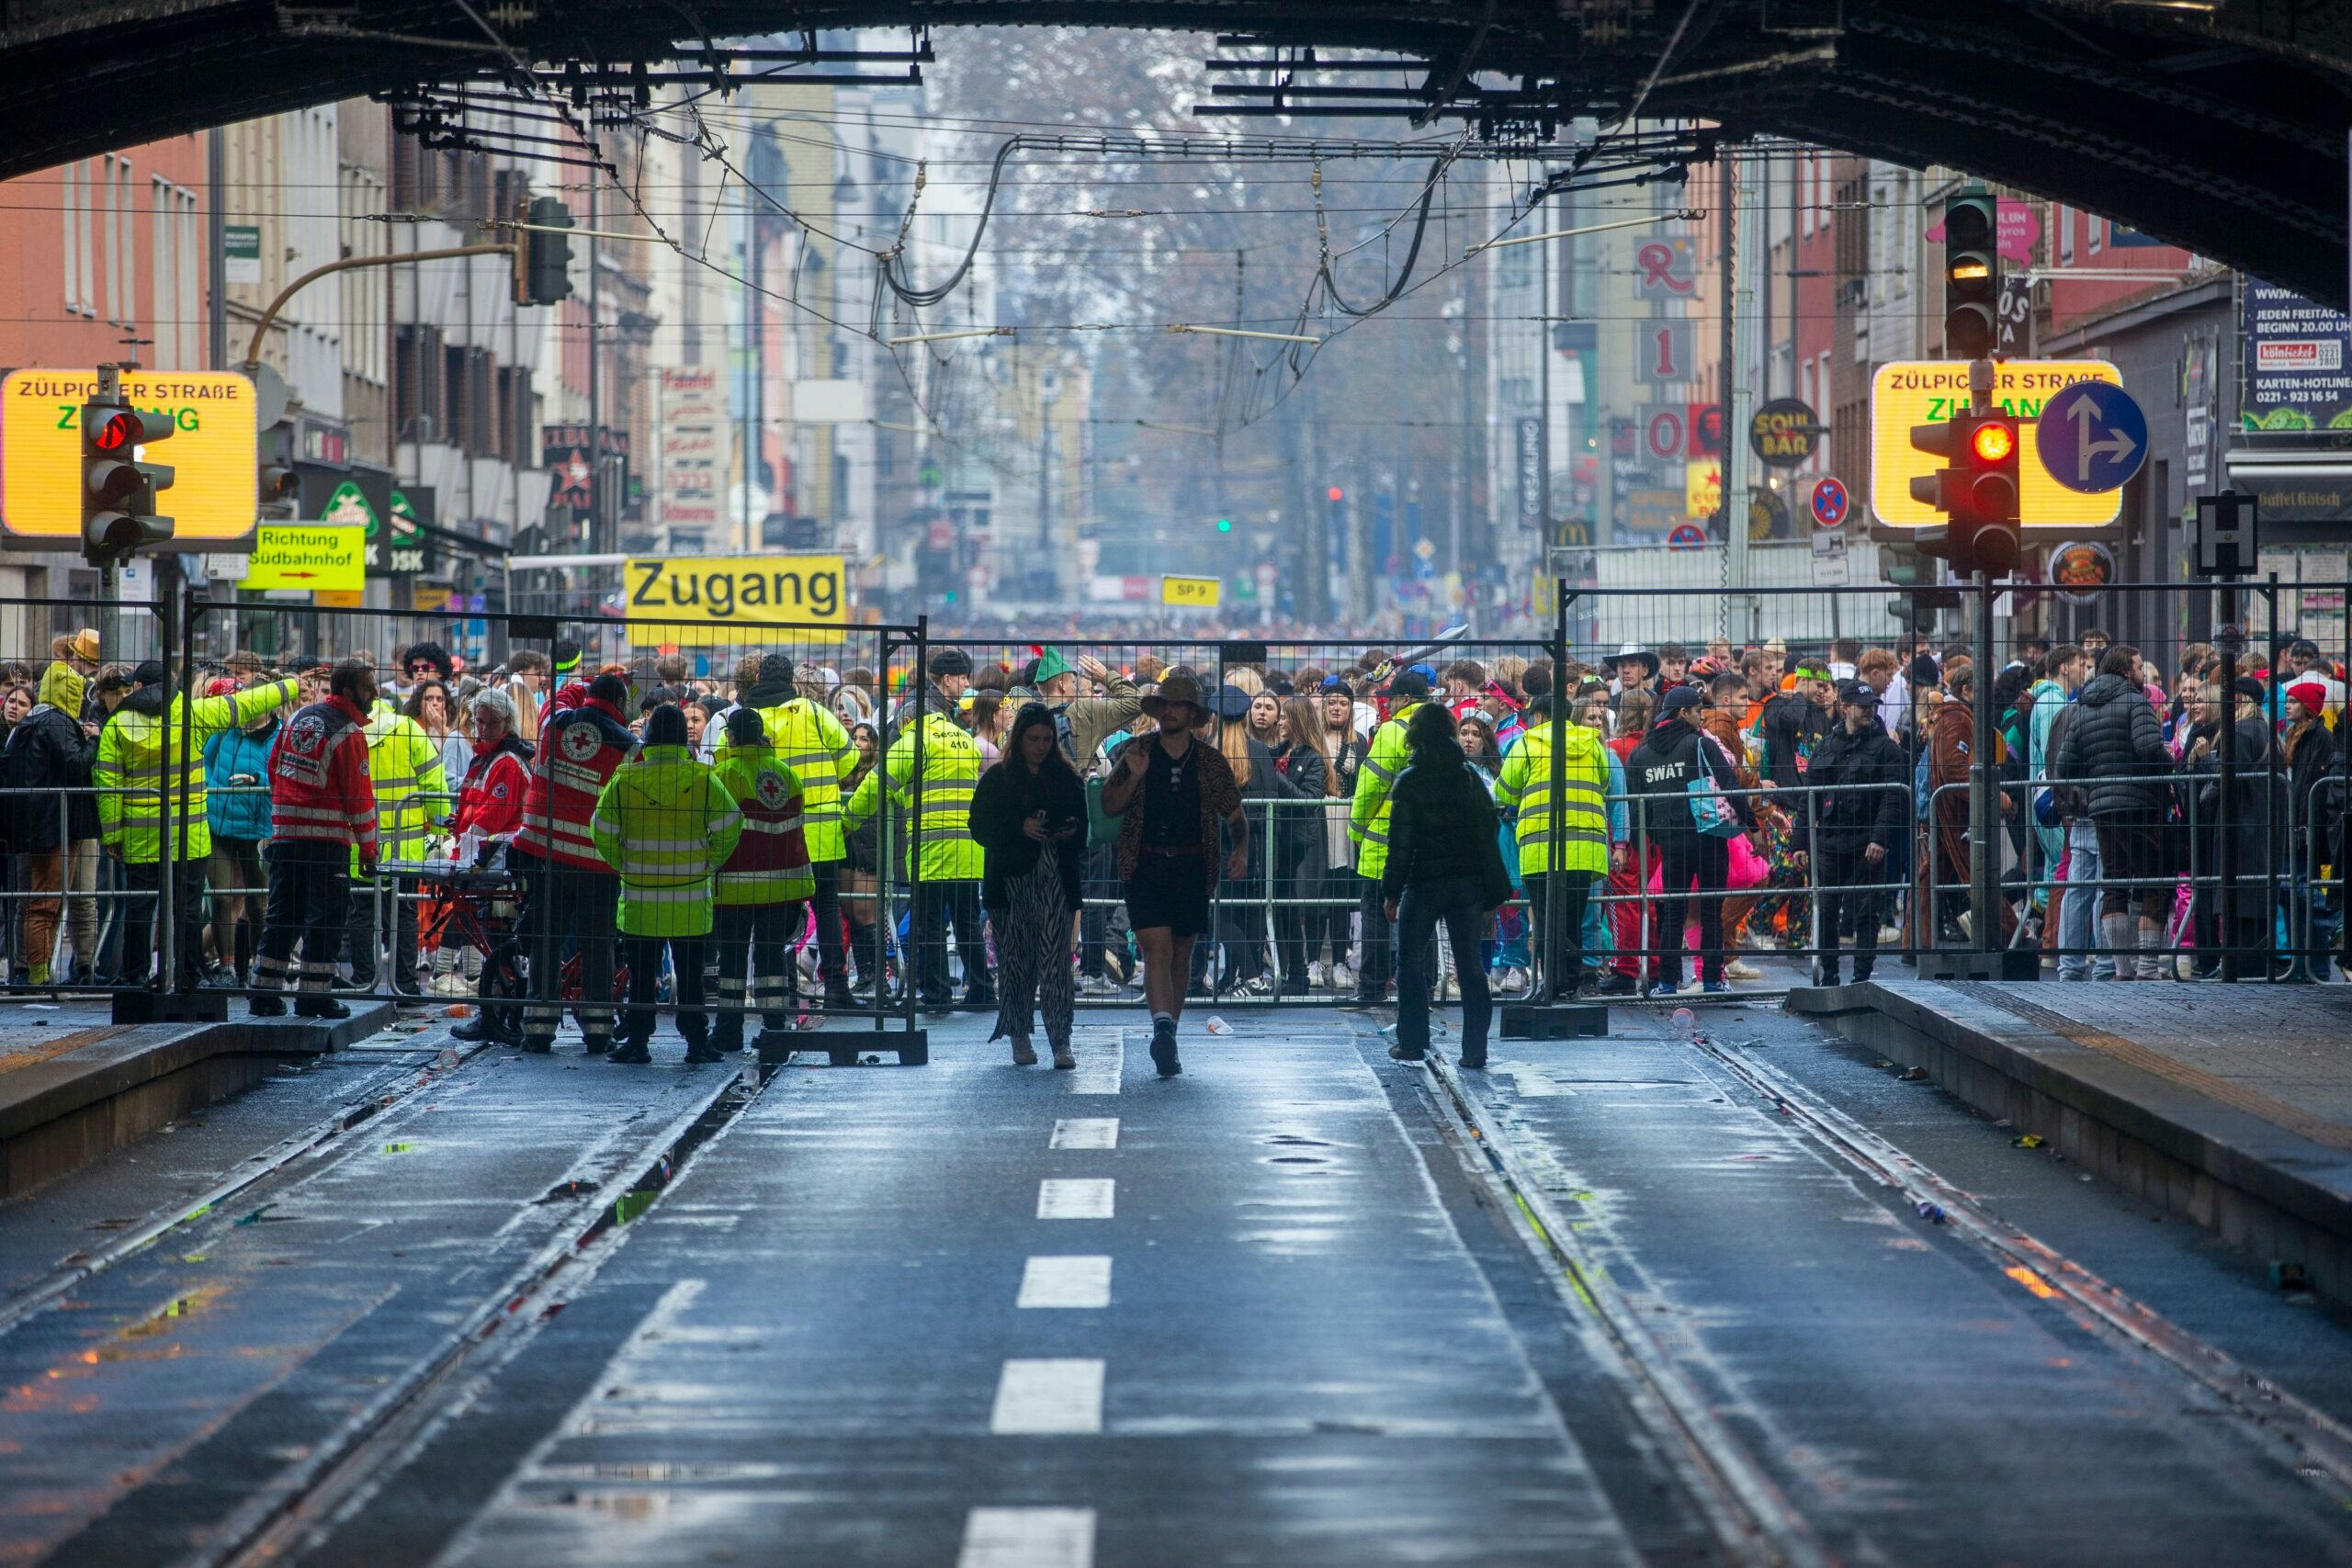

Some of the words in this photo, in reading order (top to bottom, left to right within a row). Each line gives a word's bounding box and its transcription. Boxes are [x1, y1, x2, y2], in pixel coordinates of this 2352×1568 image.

[2256, 309, 2291, 320] JEDEN
[2292, 309, 2337, 320] FREITAG
[2256, 322, 2300, 333] BEGINN
[2301, 321, 2334, 333] 20.00
[2262, 344, 2314, 358] kölnticket
[2319, 348, 2339, 357] 0221
[2319, 357, 2339, 367] 2801
[1891, 371, 2014, 389] ZÜLPICER
[19, 378, 147, 398] ZÜLPICER
[2256, 392, 2280, 403] 0221
[2290, 391, 2309, 402] 923
[2312, 391, 2323, 401] 16
[2325, 391, 2338, 401] 54
[1927, 398, 2050, 421] ZUAN
[1762, 435, 1807, 456] BAR
[263, 532, 338, 549] Richtung
[2202, 504, 2253, 567] H
[249, 551, 353, 566] Südbahnhof
[632, 561, 838, 617] Zugang
[1177, 584, 1194, 596] SP
[1198, 586, 1206, 597] 9
[950, 740, 969, 750] 410
[1645, 761, 1685, 783] SWAT
